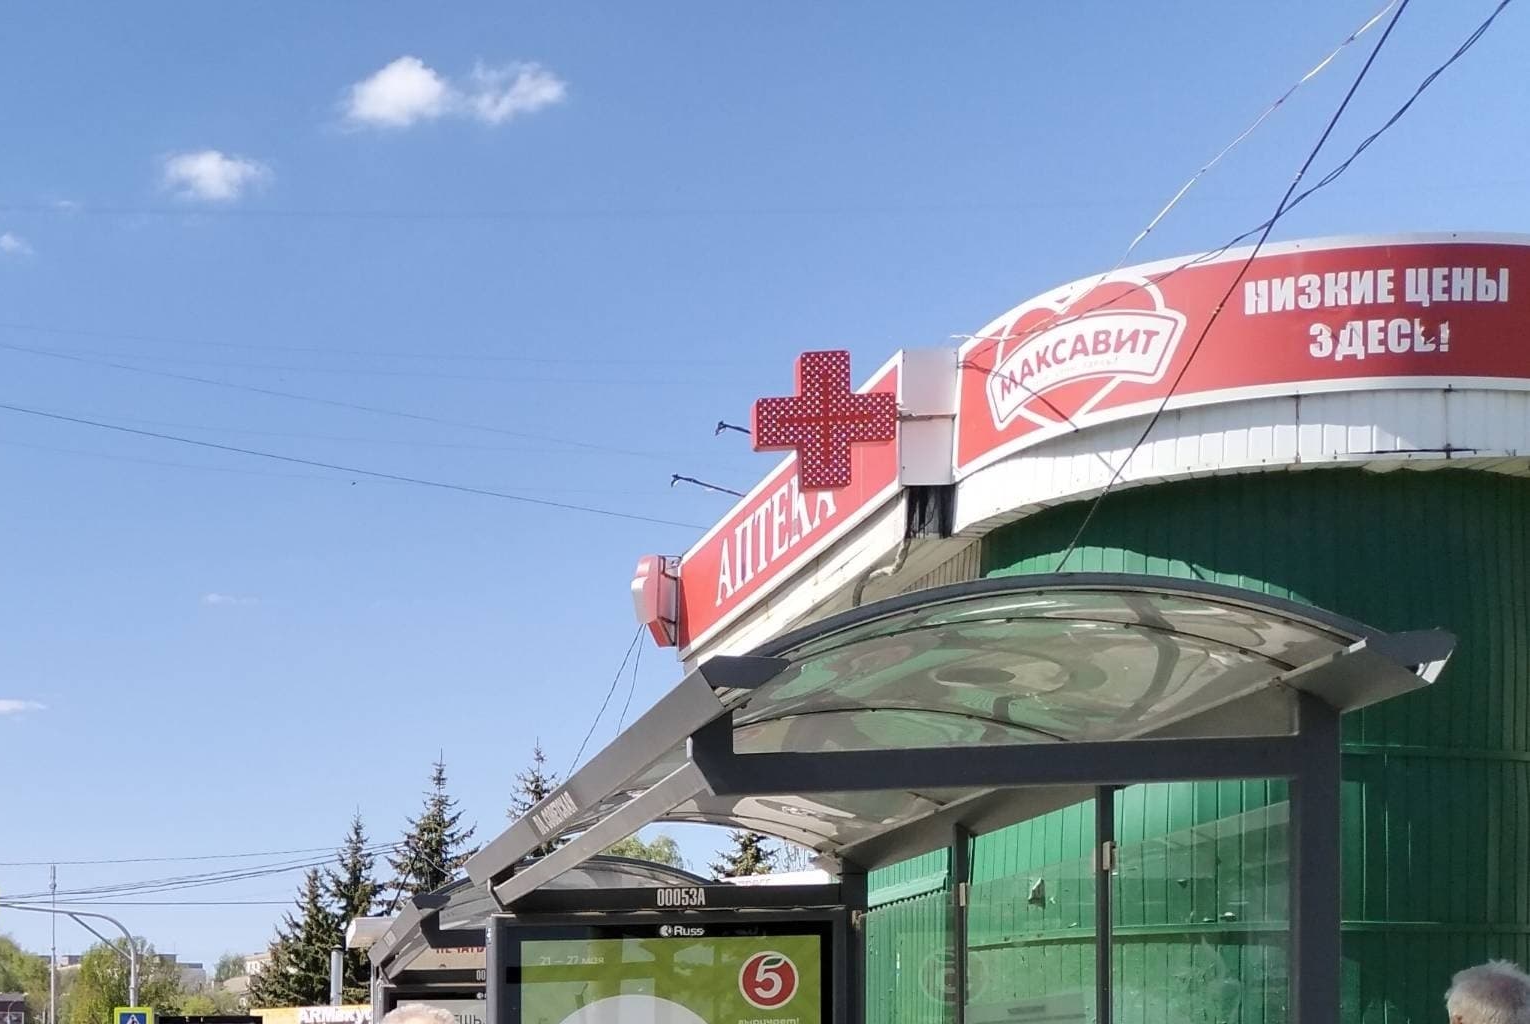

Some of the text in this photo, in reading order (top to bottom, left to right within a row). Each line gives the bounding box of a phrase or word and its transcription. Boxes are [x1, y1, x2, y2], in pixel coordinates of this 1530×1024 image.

[1244, 267, 1510, 315] НИЗКИЕ ЦЕНЫ
[1309, 318, 1450, 361] ЗДЕСЬ!
[1000, 329, 1160, 401] МАКСАВИТ
[656, 887, 706, 906] 00053A
[673, 926, 705, 937] Russ
